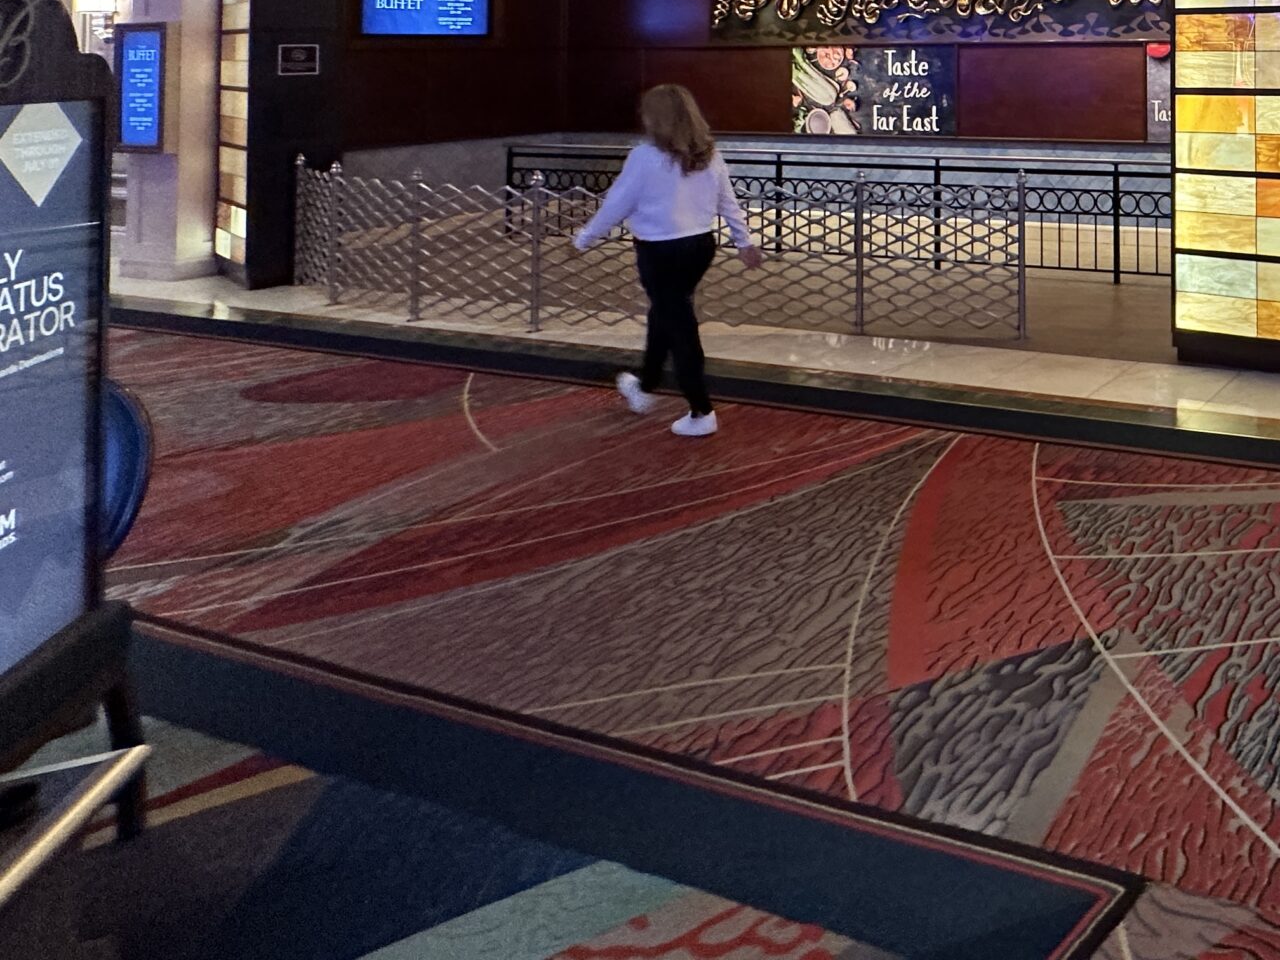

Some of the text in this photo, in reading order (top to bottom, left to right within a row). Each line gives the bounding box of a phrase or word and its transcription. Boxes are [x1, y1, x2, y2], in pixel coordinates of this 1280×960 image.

[884, 49, 929, 76] Taste
[882, 81, 931, 102] of the
[873, 104, 940, 132] Far East
